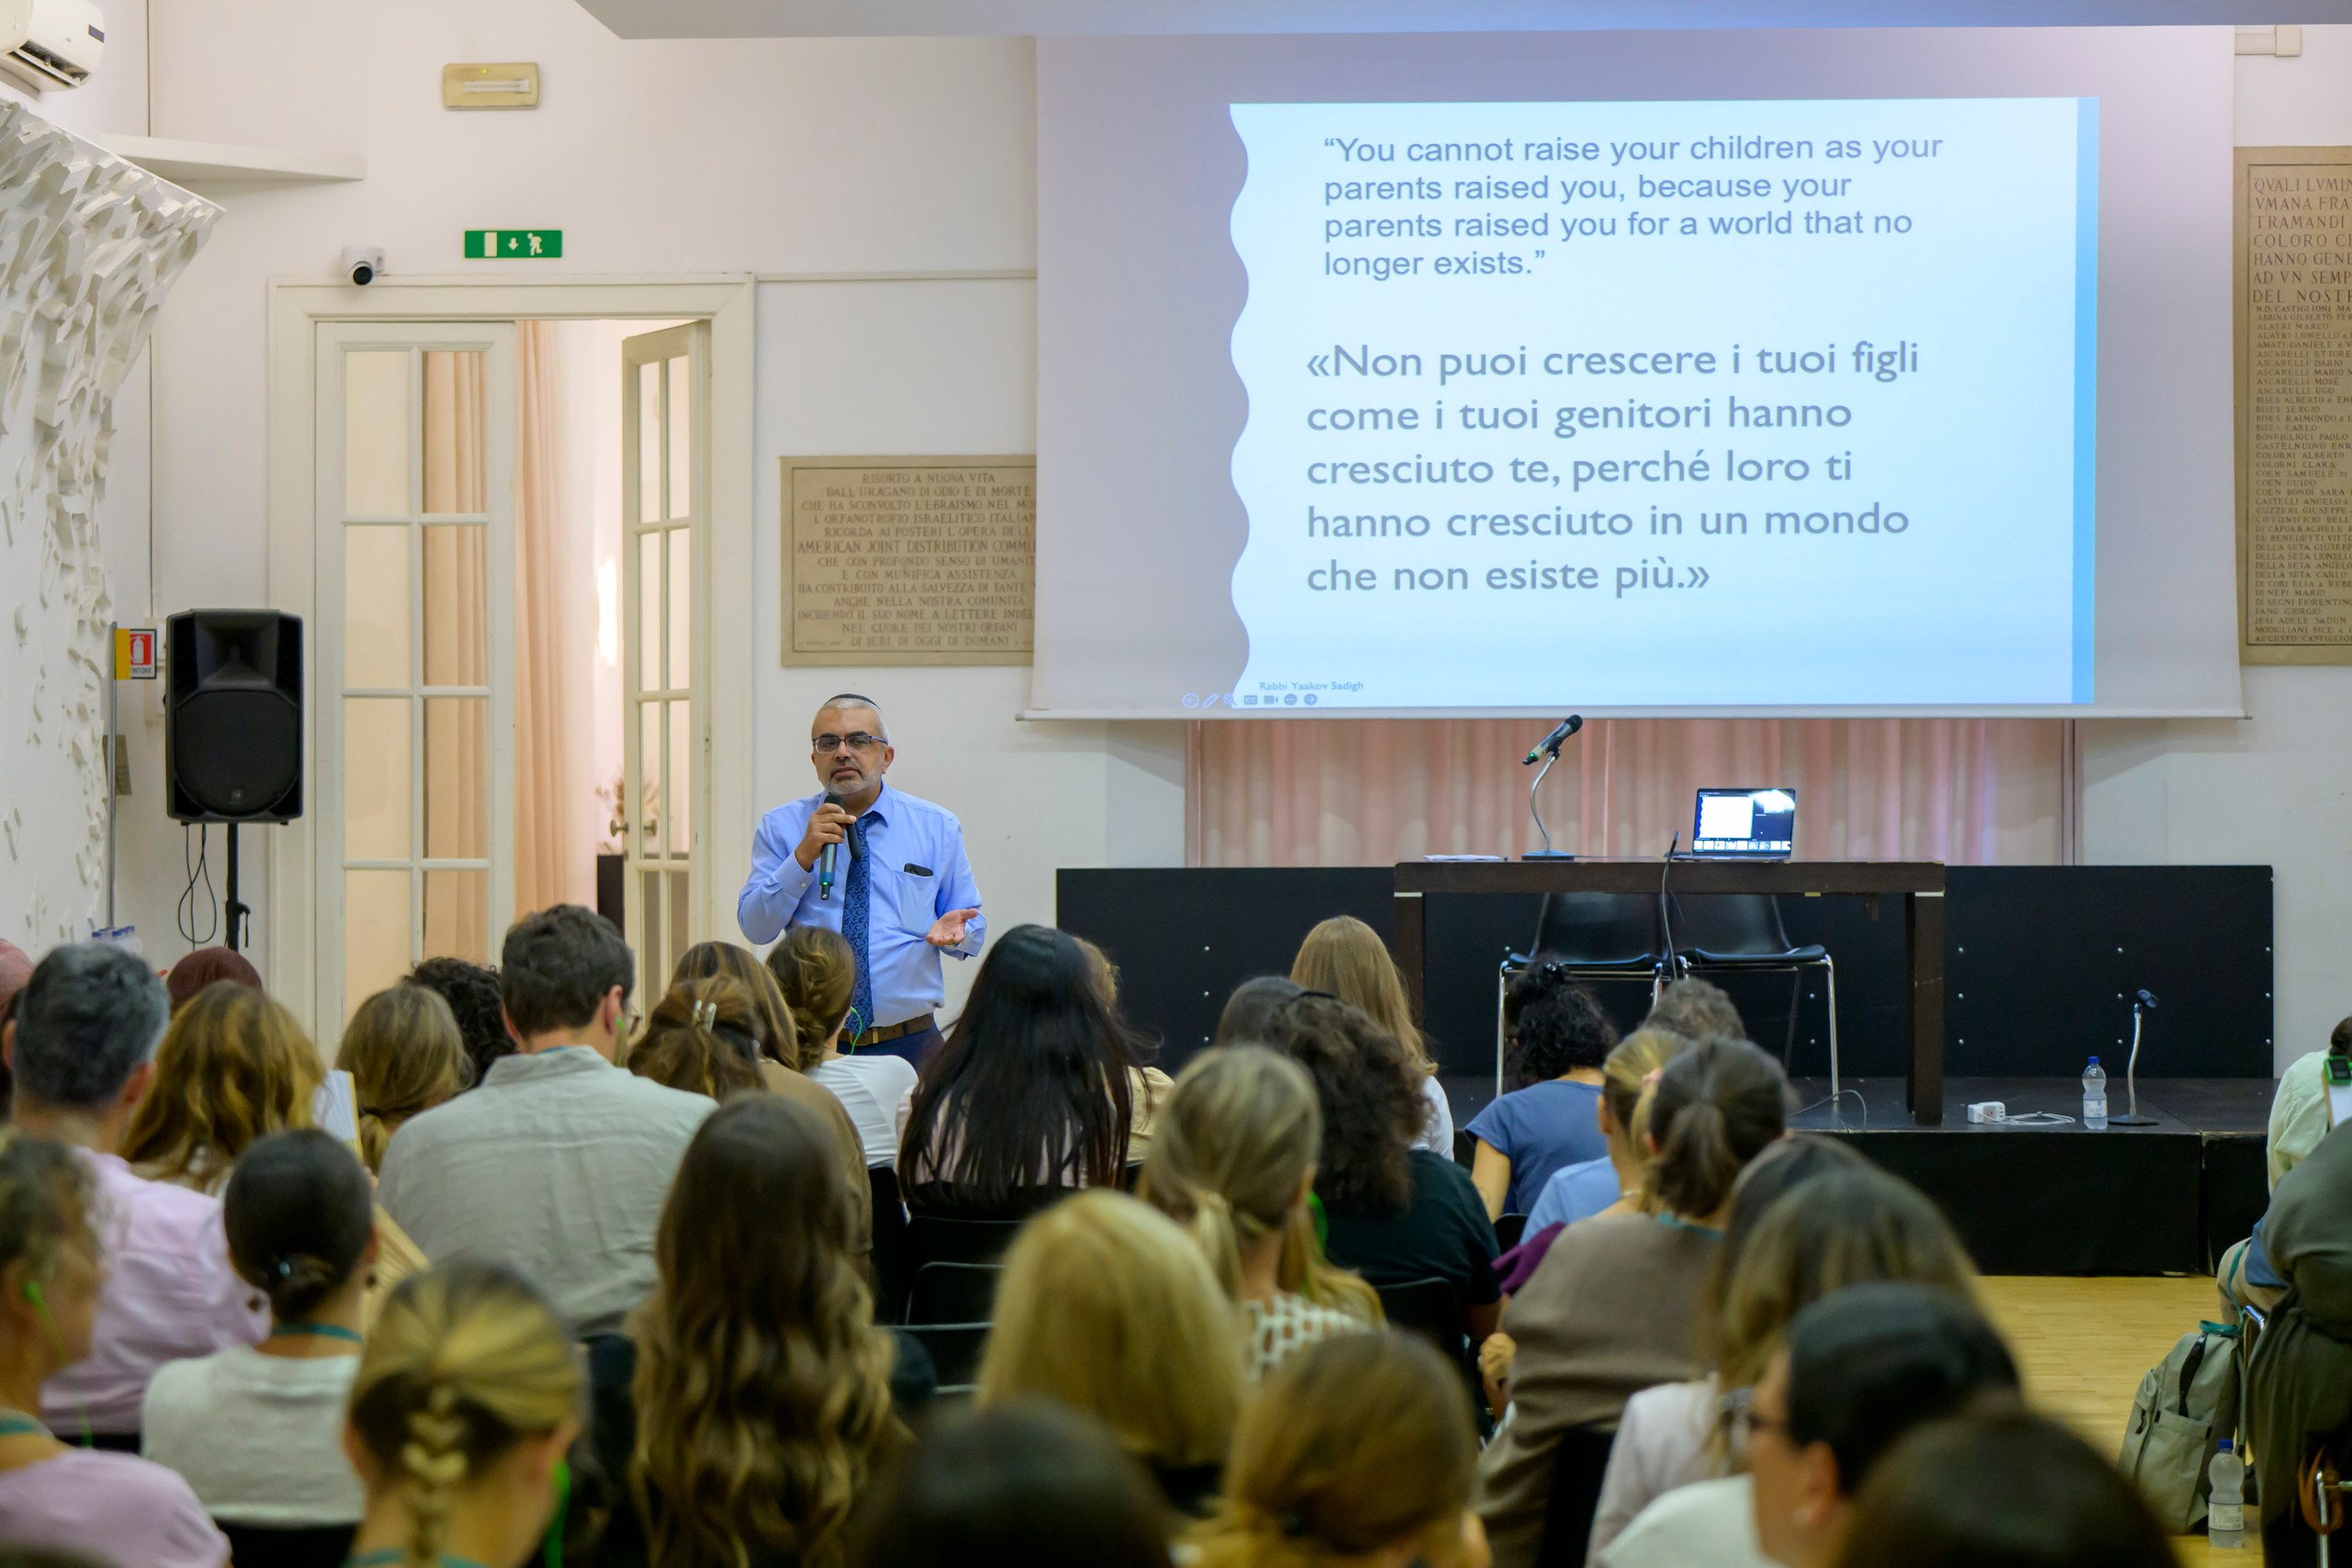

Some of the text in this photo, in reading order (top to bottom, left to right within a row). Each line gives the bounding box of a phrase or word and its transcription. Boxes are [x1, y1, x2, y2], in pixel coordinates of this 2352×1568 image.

[1407, 137, 1514, 163] cannot
[1524, 136, 1600, 162] raise
[1610, 141, 1681, 167] your
[1690, 134, 1814, 161] children
[1825, 140, 1862, 159] as
[1872, 139, 1944, 165] your
[1325, 174, 1852, 207] parents raised you, because your
[2255, 197, 2352, 210] VMANA FRA
[1325, 209, 1913, 244] parents raised you for a world that no
[2255, 215, 2345, 229] TRAMANDI
[2254, 233, 2327, 248] COLORO
[2254, 253, 2307, 265] HANNO
[1325, 251, 1425, 282] longer
[2253, 270, 2273, 285] AD
[2279, 270, 2302, 285] VN
[2253, 289, 2286, 303] DEL
[1306, 340, 1918, 387] «Non puoi crescere i tuoi figli
[1306, 395, 1852, 439] come i tuoi genitori hanno
[1306, 448, 1852, 493] cresciuto te, perché loro ti
[862, 473, 995, 484] RISORTO A NUOVA VITA
[920, 485, 930, 497] DI
[933, 485, 960, 497] ODIO
[964, 485, 971, 497] E
[977, 485, 987, 497] DI
[991, 485, 1031, 497] MORTE
[801, 500, 824, 511] CHE
[829, 500, 844, 511] HA
[849, 500, 911, 511] SCONVOLTO
[987, 500, 1011, 511] NEL
[913, 513, 985, 525] ISRAELITICO
[1307, 501, 1909, 537] hanno cresciuto in un mondo
[824, 525, 874, 537] RICORDA
[879, 525, 890, 537] AI
[896, 525, 943, 537] POSTERI
[797, 539, 862, 554] AMERICAN
[868, 539, 901, 554] JOINT
[908, 539, 989, 554] DISTRIBUTION
[818, 556, 840, 567] CHE
[847, 556, 868, 567] CON
[874, 556, 930, 567] PROFONDO
[935, 556, 971, 567] SENSO
[976, 556, 986, 567] DI
[842, 569, 1017, 580] E CON MUNIFICA ASSISTENZA
[1307, 556, 1711, 600] che non esiste più.»
[797, 581, 812, 593] HA
[816, 581, 885, 593] CONTRIBUITO
[888, 581, 918, 593] ALLA
[921, 581, 974, 593] SALVEZZA
[978, 581, 989, 593] DI
[993, 581, 1027, 593] TANTE
[832, 595, 870, 606] ANCHE
[876, 595, 913, 606] NELLA
[919, 595, 962, 606] NOSTRA
[797, 608, 854, 620] INCIDENDO
[857, 608, 868, 620] IL
[872, 608, 892, 620] SUO
[896, 608, 927, 620] NOME
[932, 608, 940, 620] A
[944, 608, 999, 620] LETTERE
[842, 622, 1018, 634] NEL CUORE DEI NOSTRI ORFANI
[851, 635, 862, 647] DI
[867, 635, 892, 647] IERI
[898, 635, 909, 647] DI
[914, 635, 942, 647] OGGI
[947, 635, 958, 647] DI
[965, 635, 1011, 647] DOMANI
[1259, 681, 1364, 692] Rabbi Yaakov Sadigh
